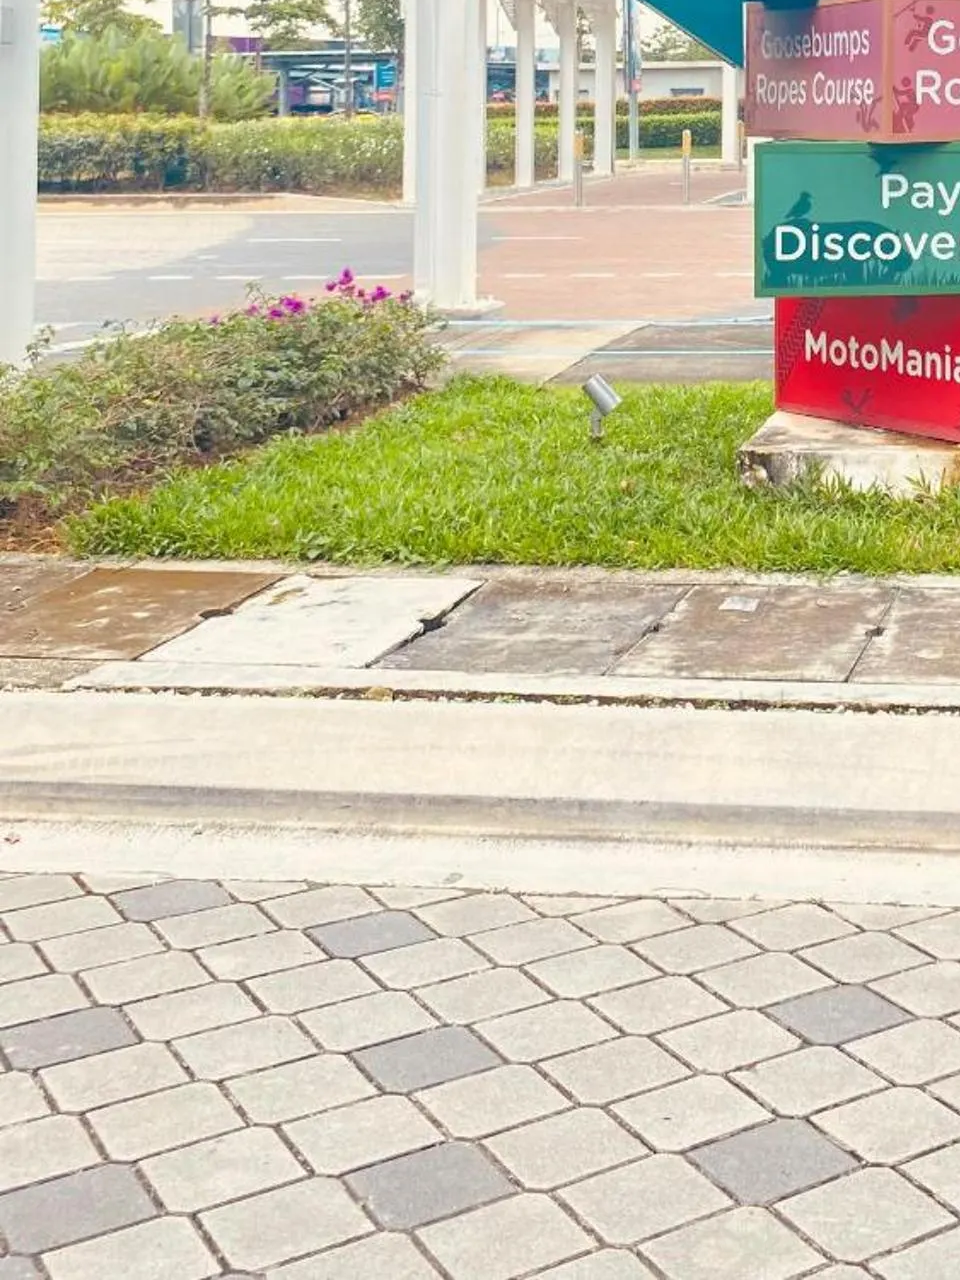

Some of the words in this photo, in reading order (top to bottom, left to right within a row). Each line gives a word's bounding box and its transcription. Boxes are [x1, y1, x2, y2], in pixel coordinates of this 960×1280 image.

[761, 25, 870, 63] Goosebumps
[756, 73, 807, 112] Ropes
[812, 71, 875, 105] Course
